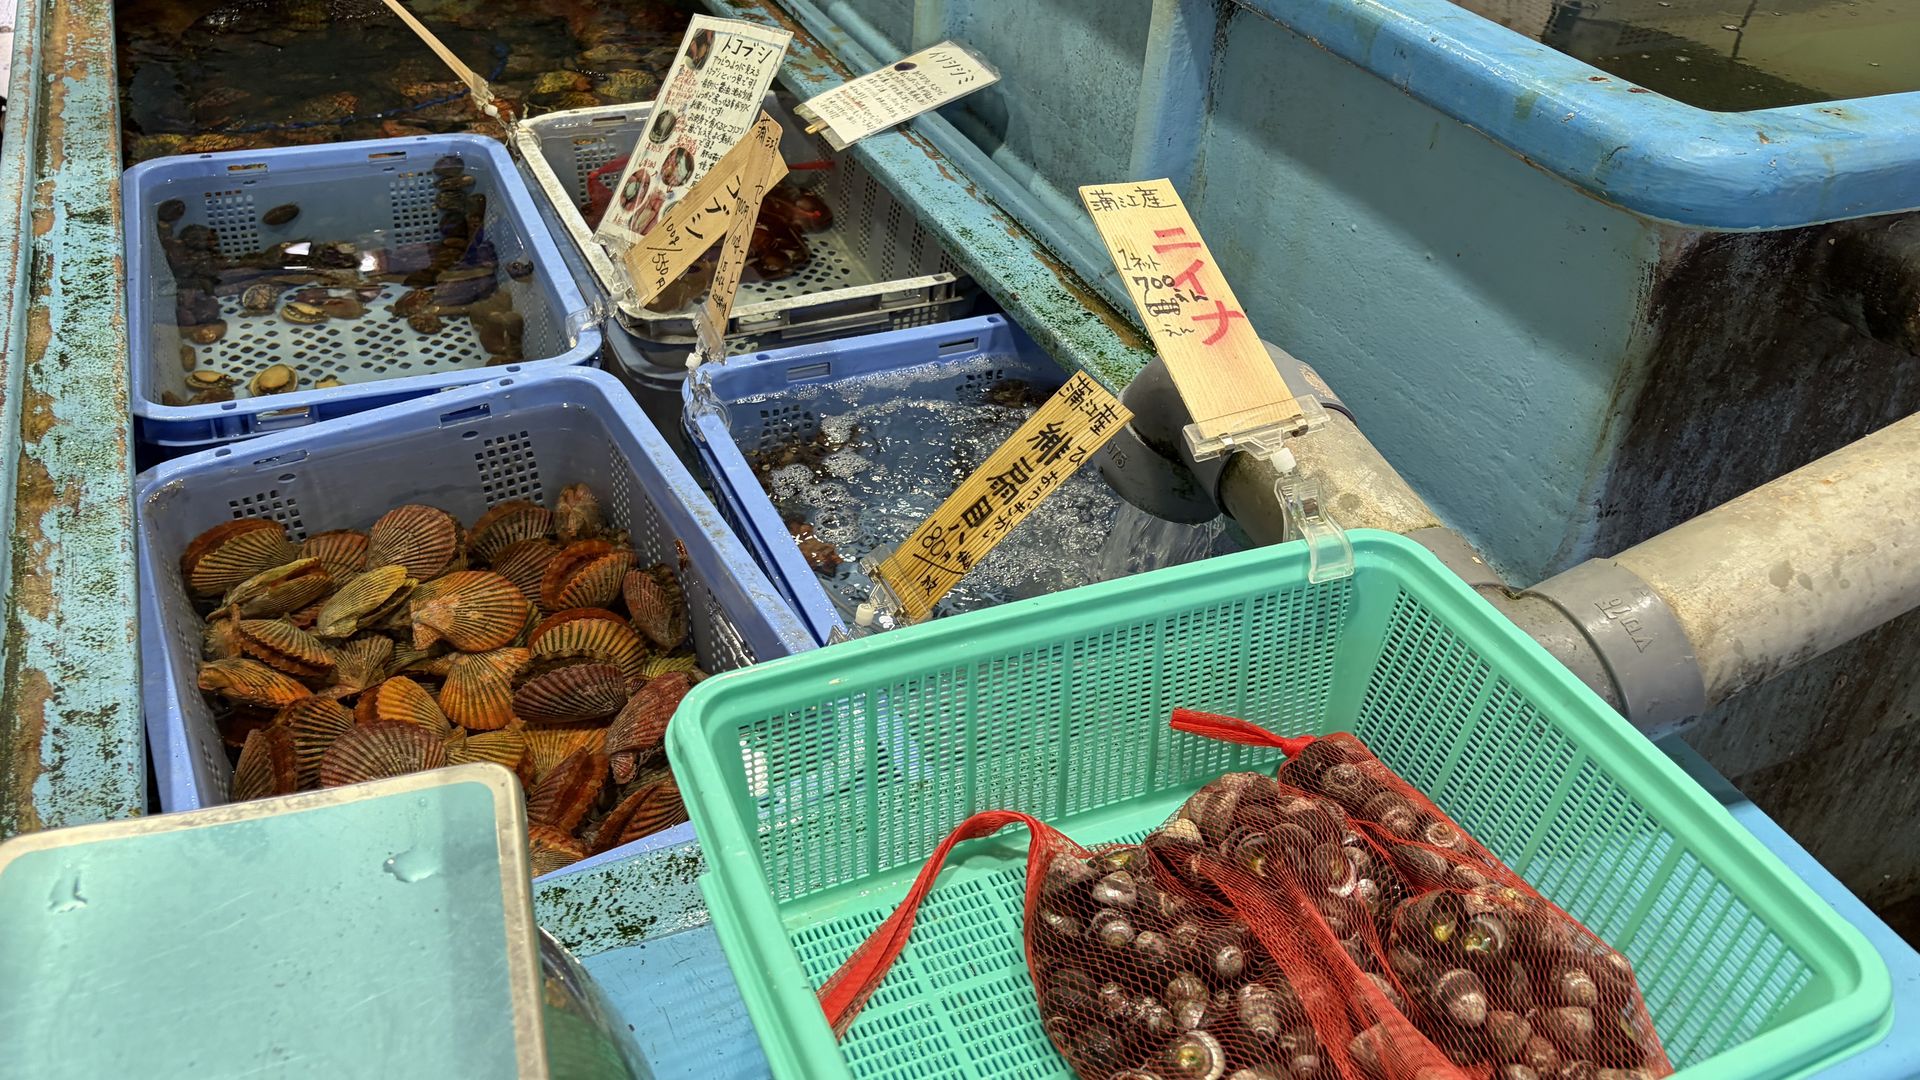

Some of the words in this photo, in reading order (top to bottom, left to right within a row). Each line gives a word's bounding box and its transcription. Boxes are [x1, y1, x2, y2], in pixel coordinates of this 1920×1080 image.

[721, 35, 773, 64] トコブシ
[1090, 187, 1177, 212] 蒲江産
[1152, 227, 1245, 346] ニイナ
[1058, 375, 1118, 436] 蒲江産
